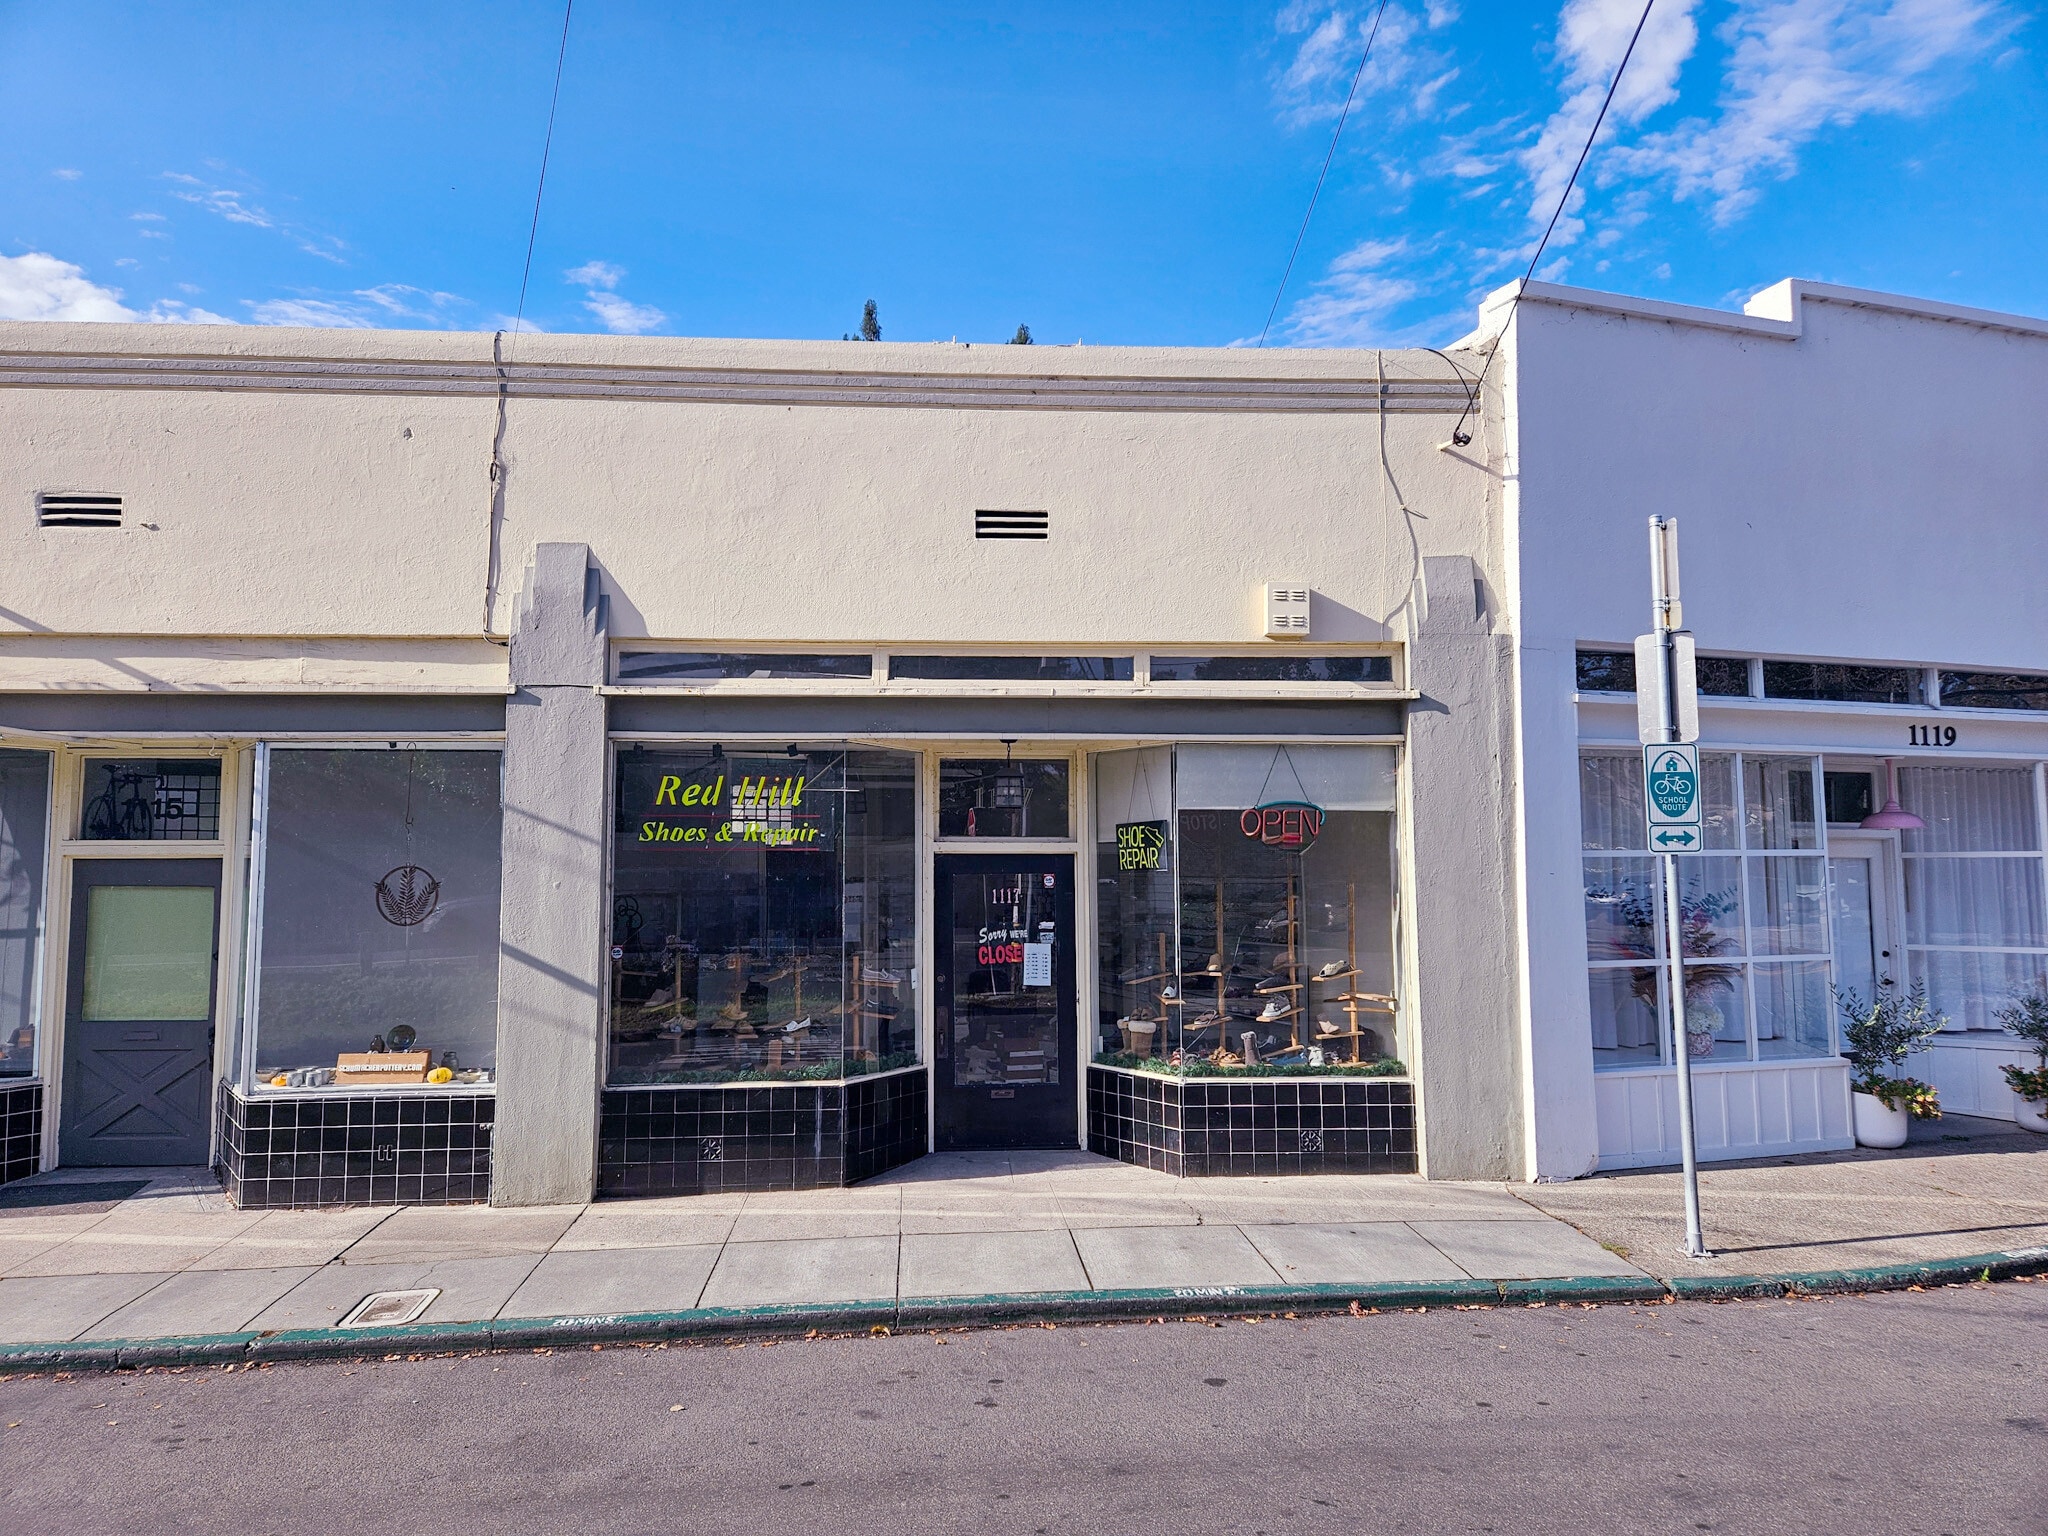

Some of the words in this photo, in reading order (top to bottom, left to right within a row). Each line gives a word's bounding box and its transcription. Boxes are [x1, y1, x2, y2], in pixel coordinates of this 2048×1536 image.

[1908, 724, 1957, 747] 1119
[655, 775, 724, 807] Red
[734, 775, 805, 807] Hill
[1658, 796, 1689, 804] SCHOOL
[1662, 804, 1687, 812] ROUTE
[638, 821, 708, 842] Shoes
[714, 822, 734, 842] &
[743, 822, 819, 847] Repair
[1240, 808, 1321, 839] OPEN
[1117, 825, 1146, 848] SHOE
[1119, 848, 1160, 870] REPAIR
[992, 888, 1020, 904] 1117
[979, 927, 1007, 943] Sorry
[978, 944, 1024, 965] CLOSE
